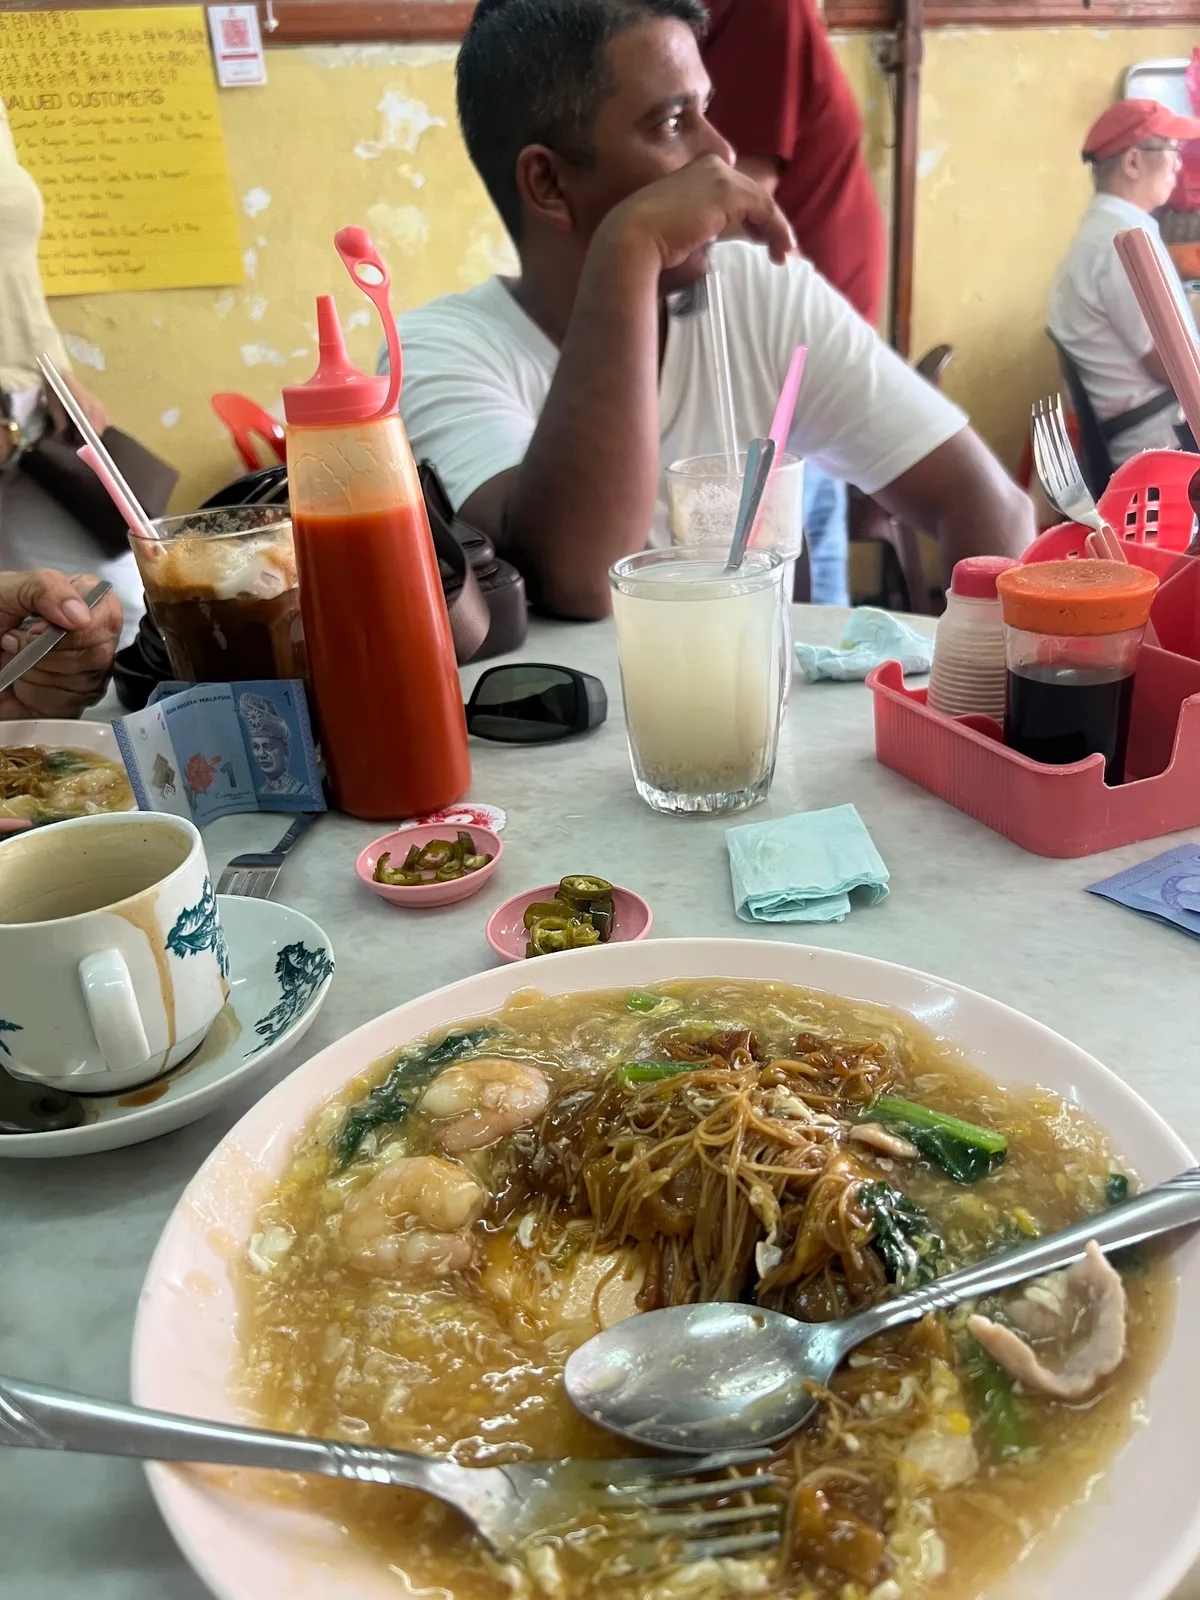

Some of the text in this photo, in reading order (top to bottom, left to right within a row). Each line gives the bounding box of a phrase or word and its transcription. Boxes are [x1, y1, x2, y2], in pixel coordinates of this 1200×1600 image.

[68, 88, 165, 109] CUSTOMERS
[199, 694, 231, 703] MALAYSIA
[220, 762, 237, 788] 1
